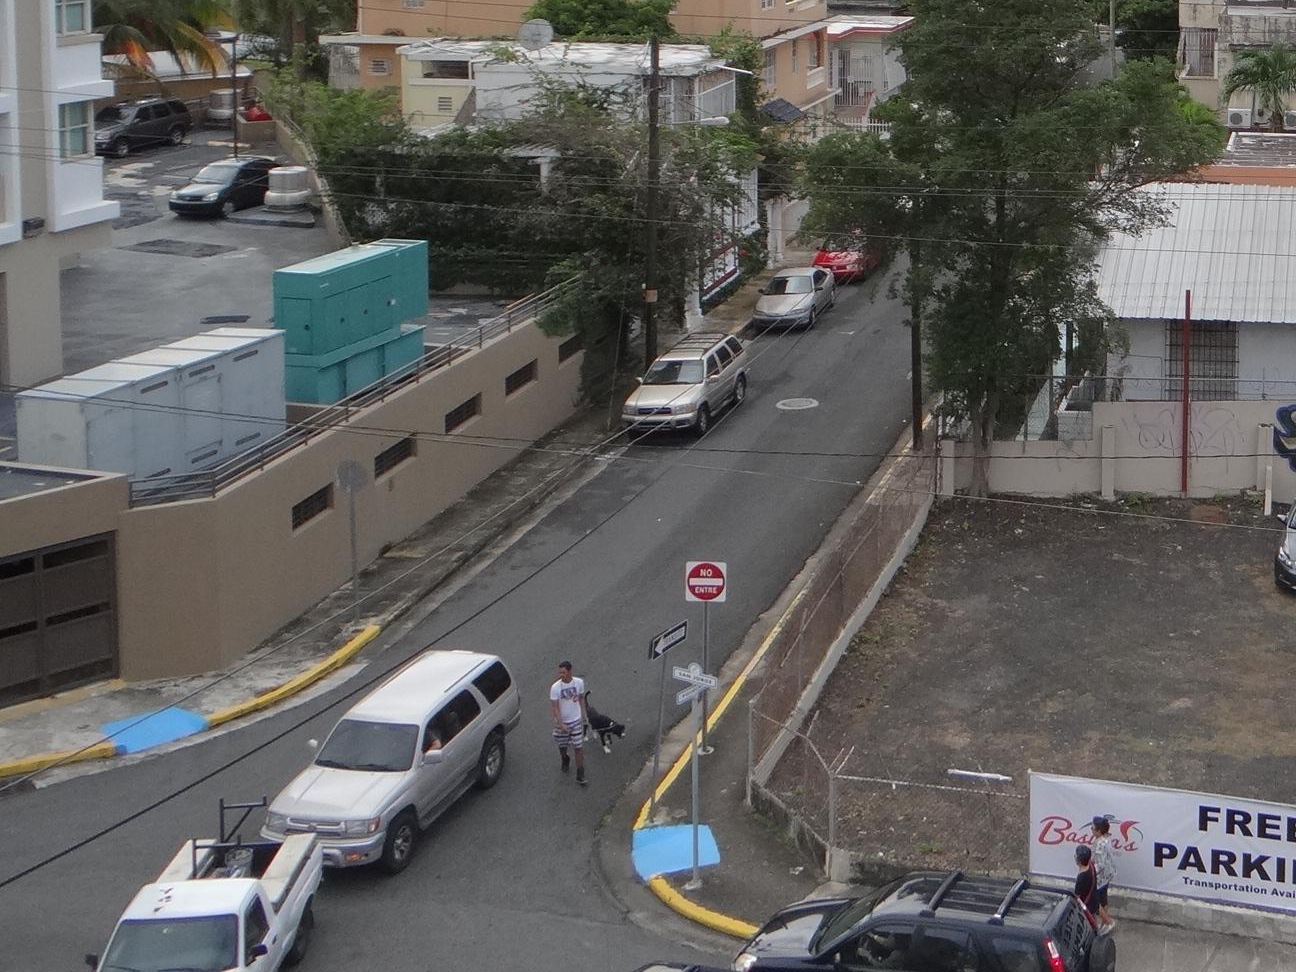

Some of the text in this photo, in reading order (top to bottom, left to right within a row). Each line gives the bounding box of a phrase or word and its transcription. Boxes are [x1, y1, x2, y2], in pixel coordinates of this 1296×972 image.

[699, 568, 713, 577] NO
[694, 586, 718, 594] ENTRE
[1038, 815, 1138, 852] Basia's
[1182, 875, 1267, 896] Transportation
